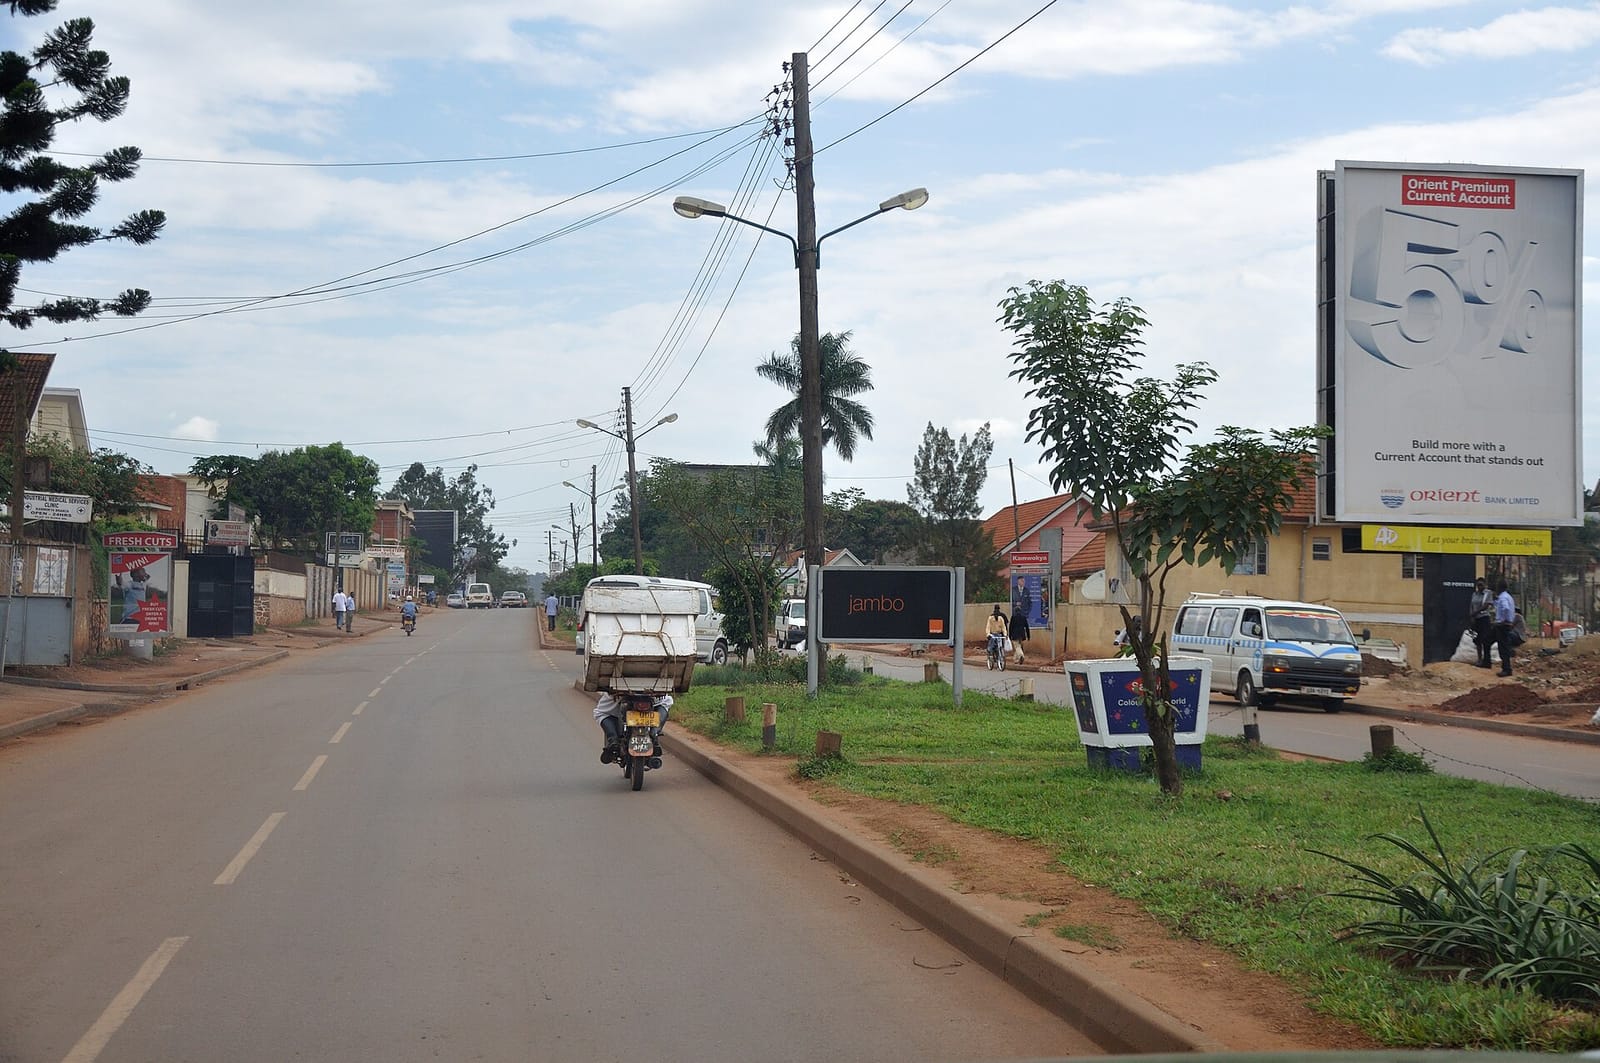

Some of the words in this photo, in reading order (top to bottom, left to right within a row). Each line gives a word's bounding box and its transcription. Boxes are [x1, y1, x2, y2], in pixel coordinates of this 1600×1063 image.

[1407, 178, 1449, 190] Orient
[1451, 180, 1509, 193] Premium
[1406, 190, 1456, 202] Current
[1458, 192, 1511, 205] Account
[1346, 206, 1549, 369] 5%
[1412, 439, 1439, 449] Build
[1442, 442, 1470, 450] more
[1472, 441, 1496, 451] with
[1374, 452, 1415, 462] Current
[1418, 453, 1462, 463] Account
[1464, 454, 1486, 464] that
[1488, 455, 1523, 466] stands
[1526, 457, 1544, 466] out
[48, 496, 68, 504] MEDICAL
[1485, 496, 1507, 504] BANK
[1509, 497, 1540, 505] LIMITED
[108, 536, 142, 546] FRESH
[144, 537, 172, 546] CUTS
[1427, 535, 1441, 544] Let
[1441, 538, 1460, 546] your
[1461, 536, 1488, 545] brands
[1489, 536, 1499, 545] do
[1501, 537, 1513, 546] the
[125, 556, 149, 570] WIN!
[847, 594, 905, 616] jambo
[1170, 697, 1187, 705] orld
